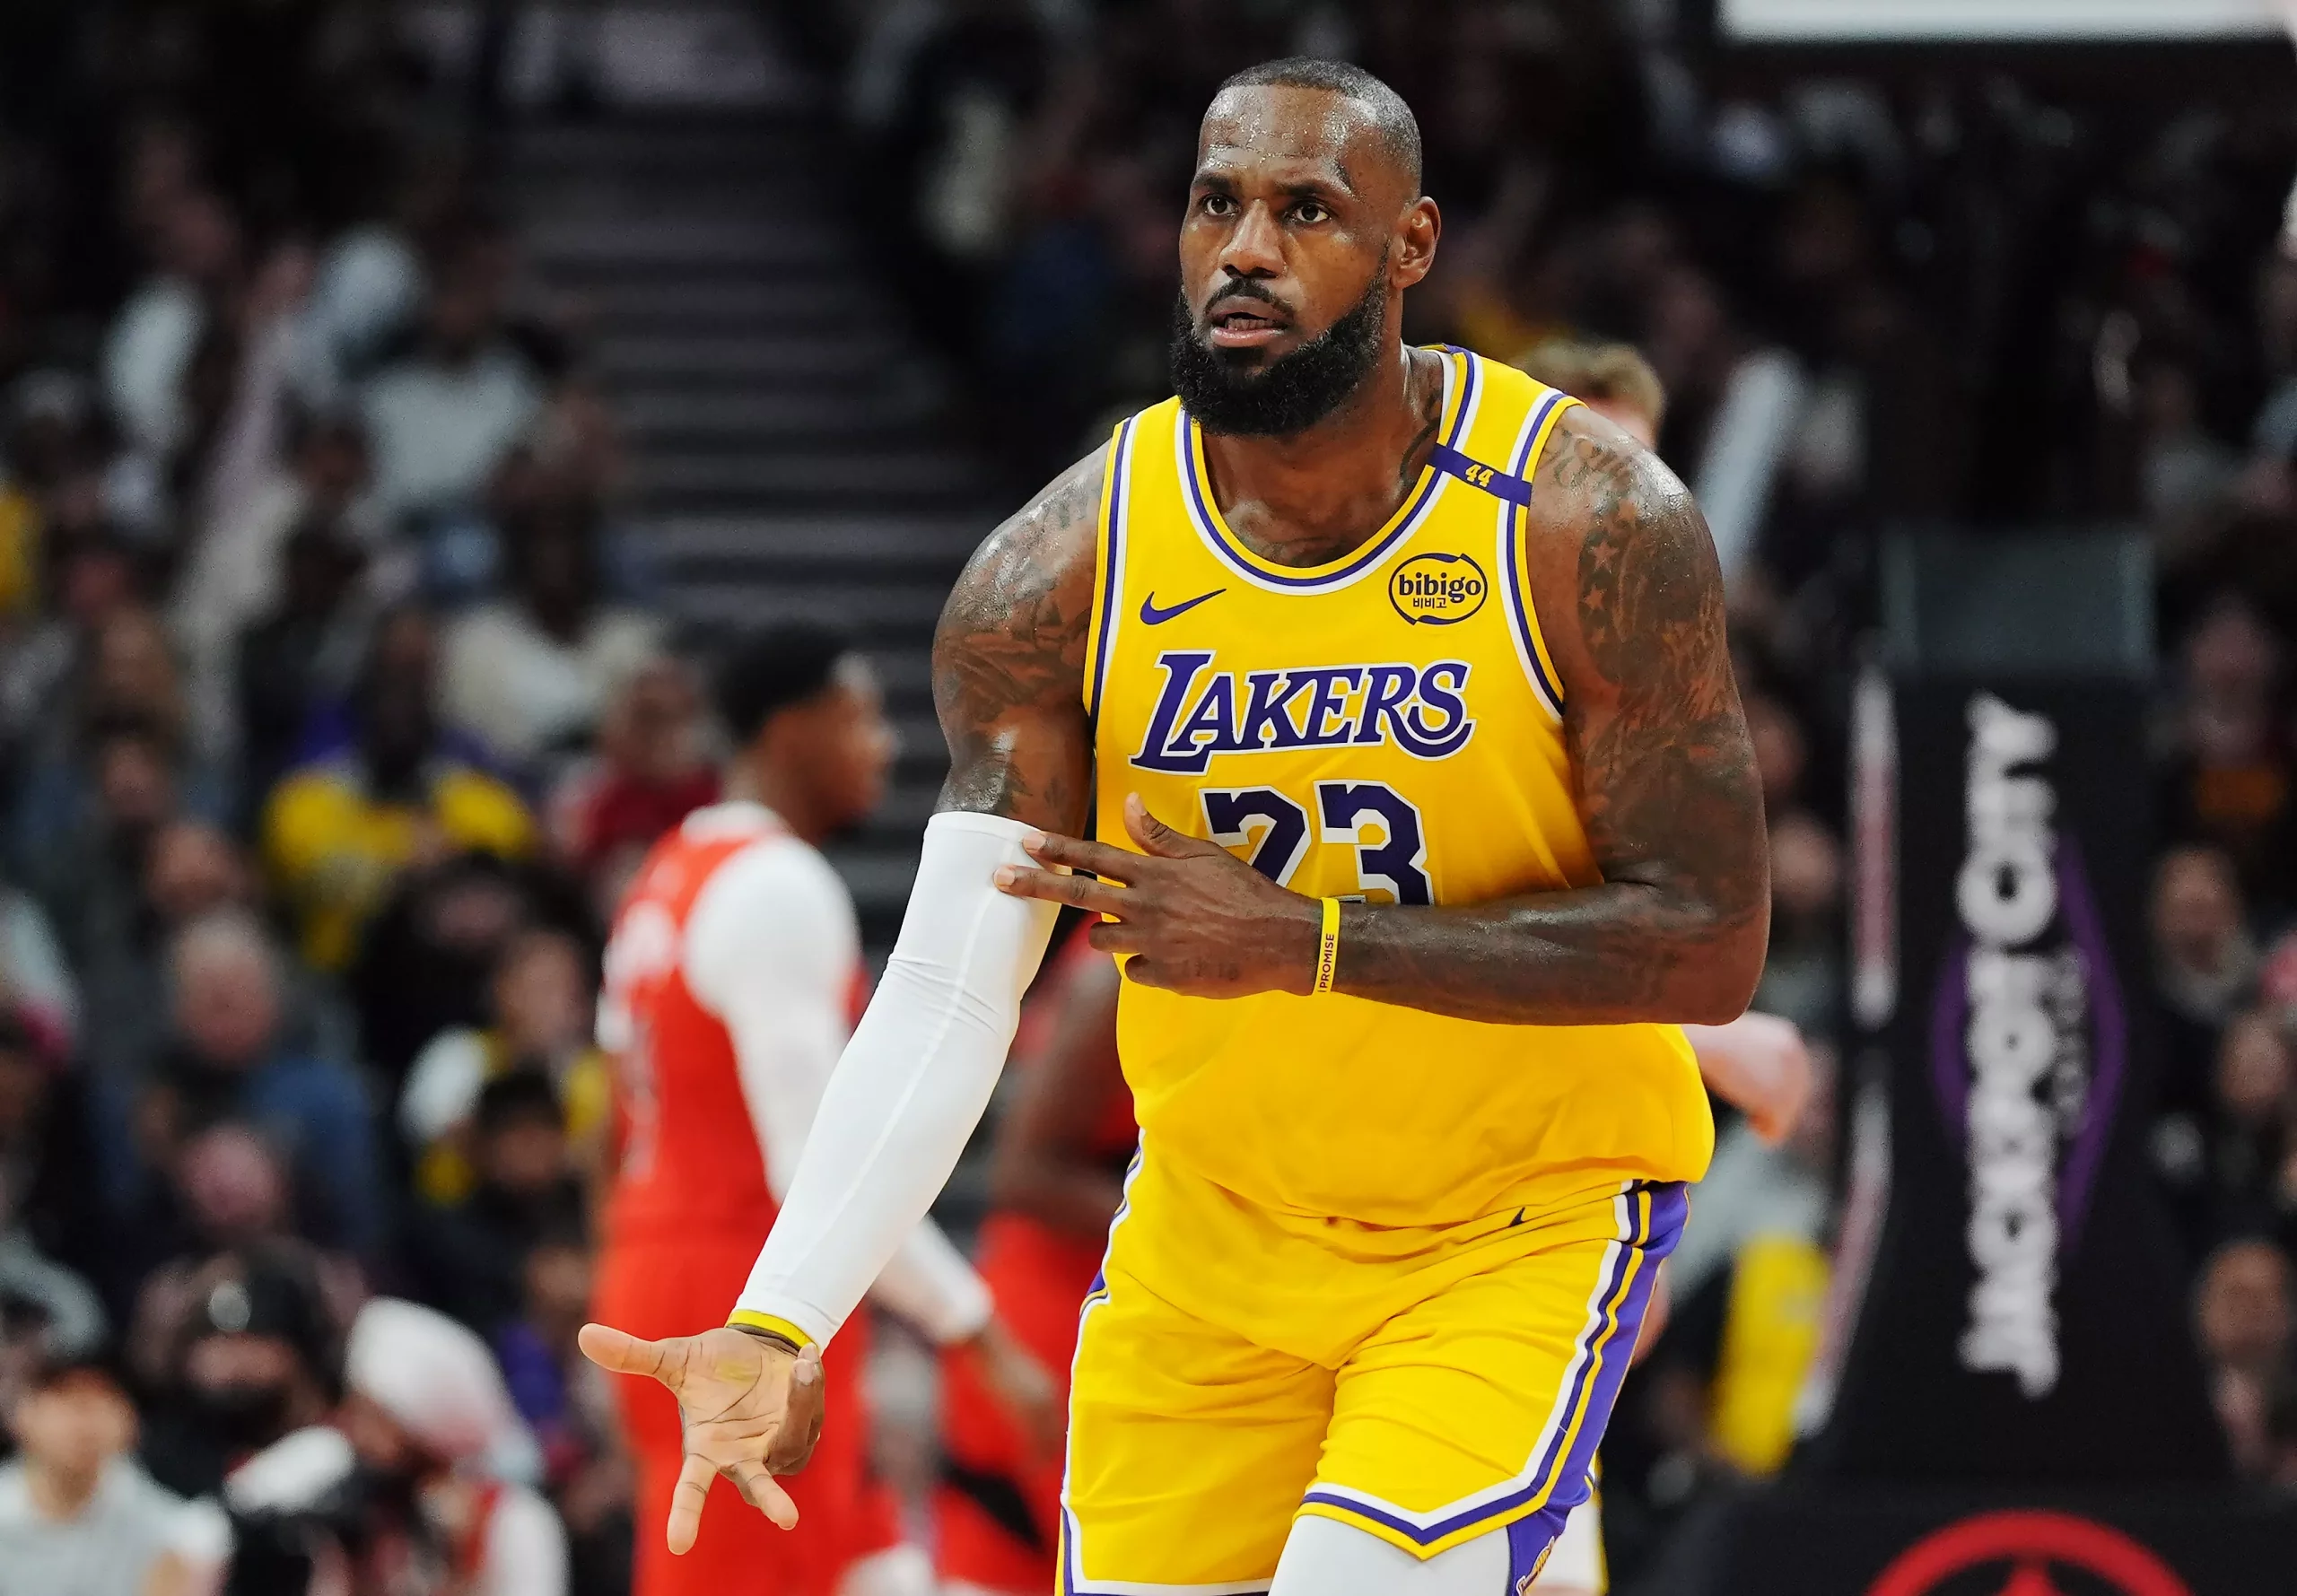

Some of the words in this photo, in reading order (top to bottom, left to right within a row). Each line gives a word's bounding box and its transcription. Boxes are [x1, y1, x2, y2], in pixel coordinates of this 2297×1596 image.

[1465, 464, 1495, 487] 44
[1399, 572, 1481, 604] bibigo
[1412, 597, 1447, 609] 비비고
[1128, 650, 1477, 776] LAKERS
[1199, 780, 1433, 906] 23
[1319, 933, 1334, 989] PROMISE
